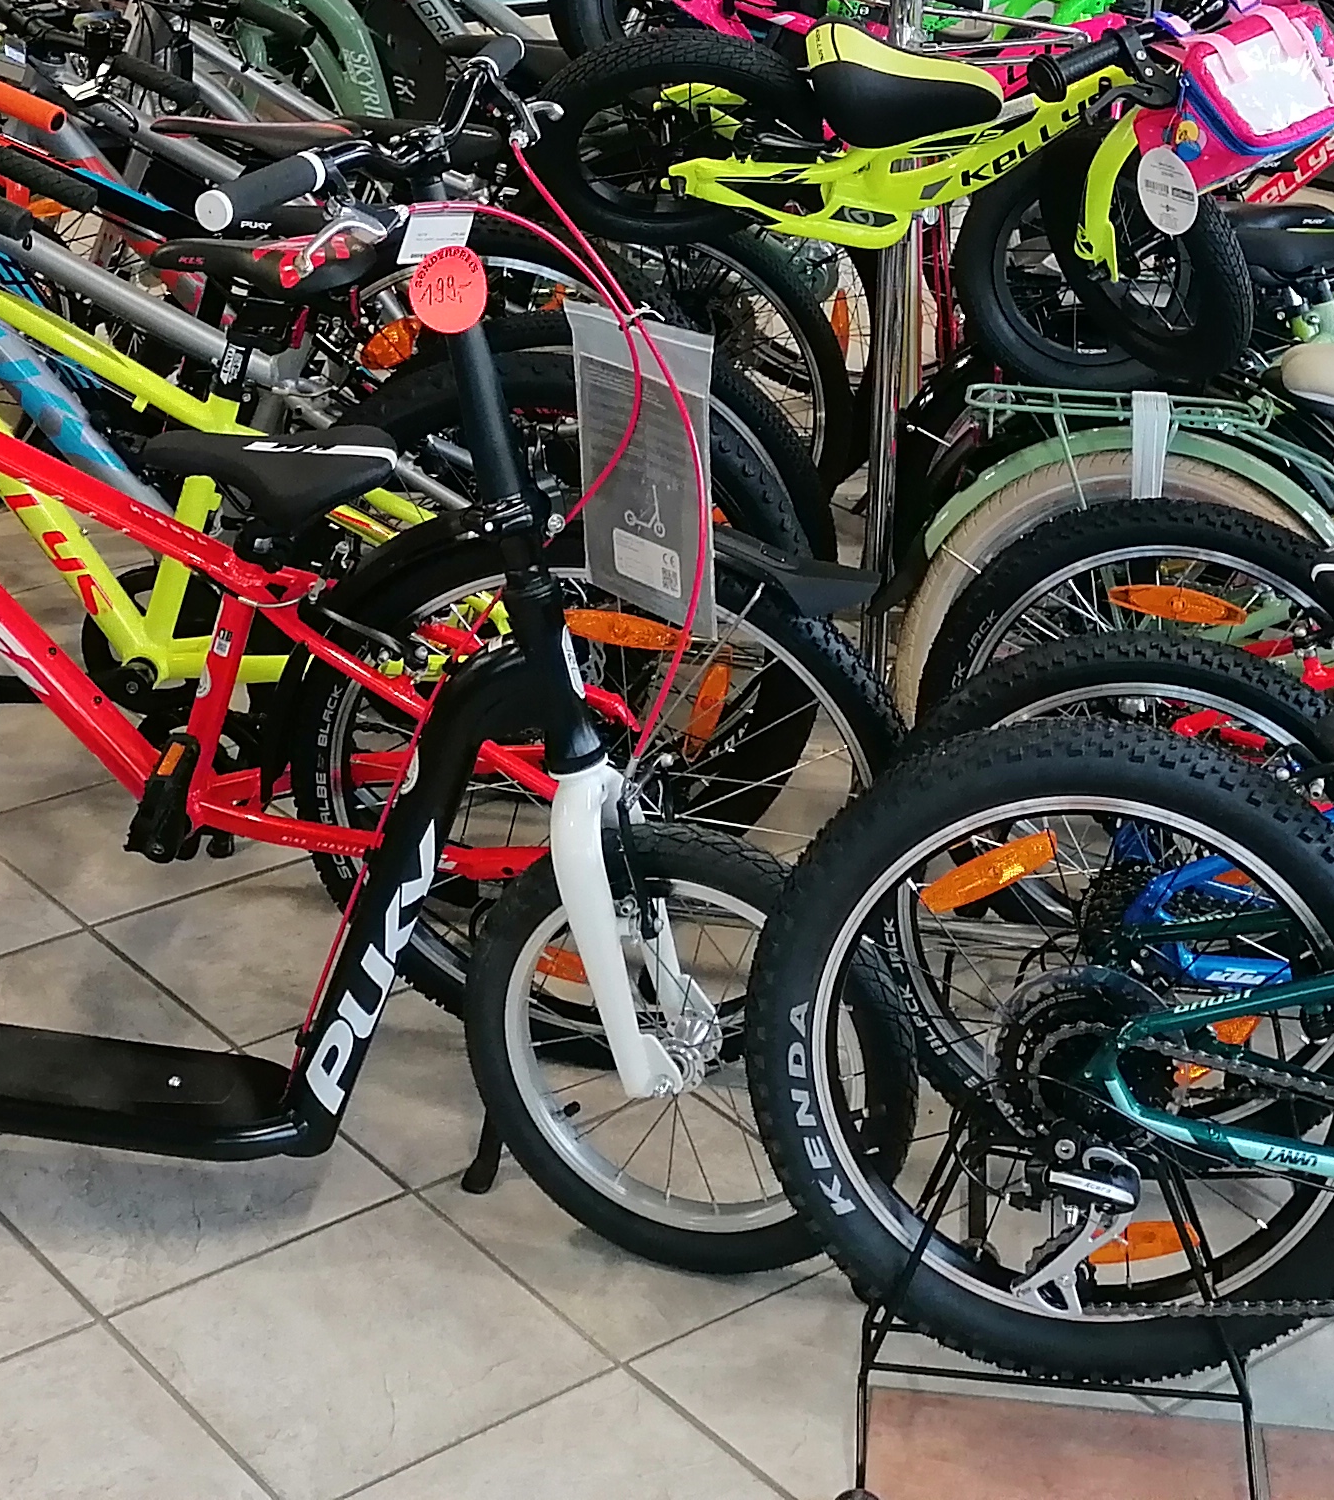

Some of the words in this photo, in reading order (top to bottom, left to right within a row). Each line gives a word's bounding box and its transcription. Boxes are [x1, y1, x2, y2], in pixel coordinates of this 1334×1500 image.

[240, 220, 272, 230] PUKY
[414, 248, 480, 289] SONDERPREIS
[318, 684, 344, 749] BLACK
[304, 818, 439, 1116] PUKY
[1205, 968, 1268, 985] KTM
[785, 1000, 856, 1218] KENDA
